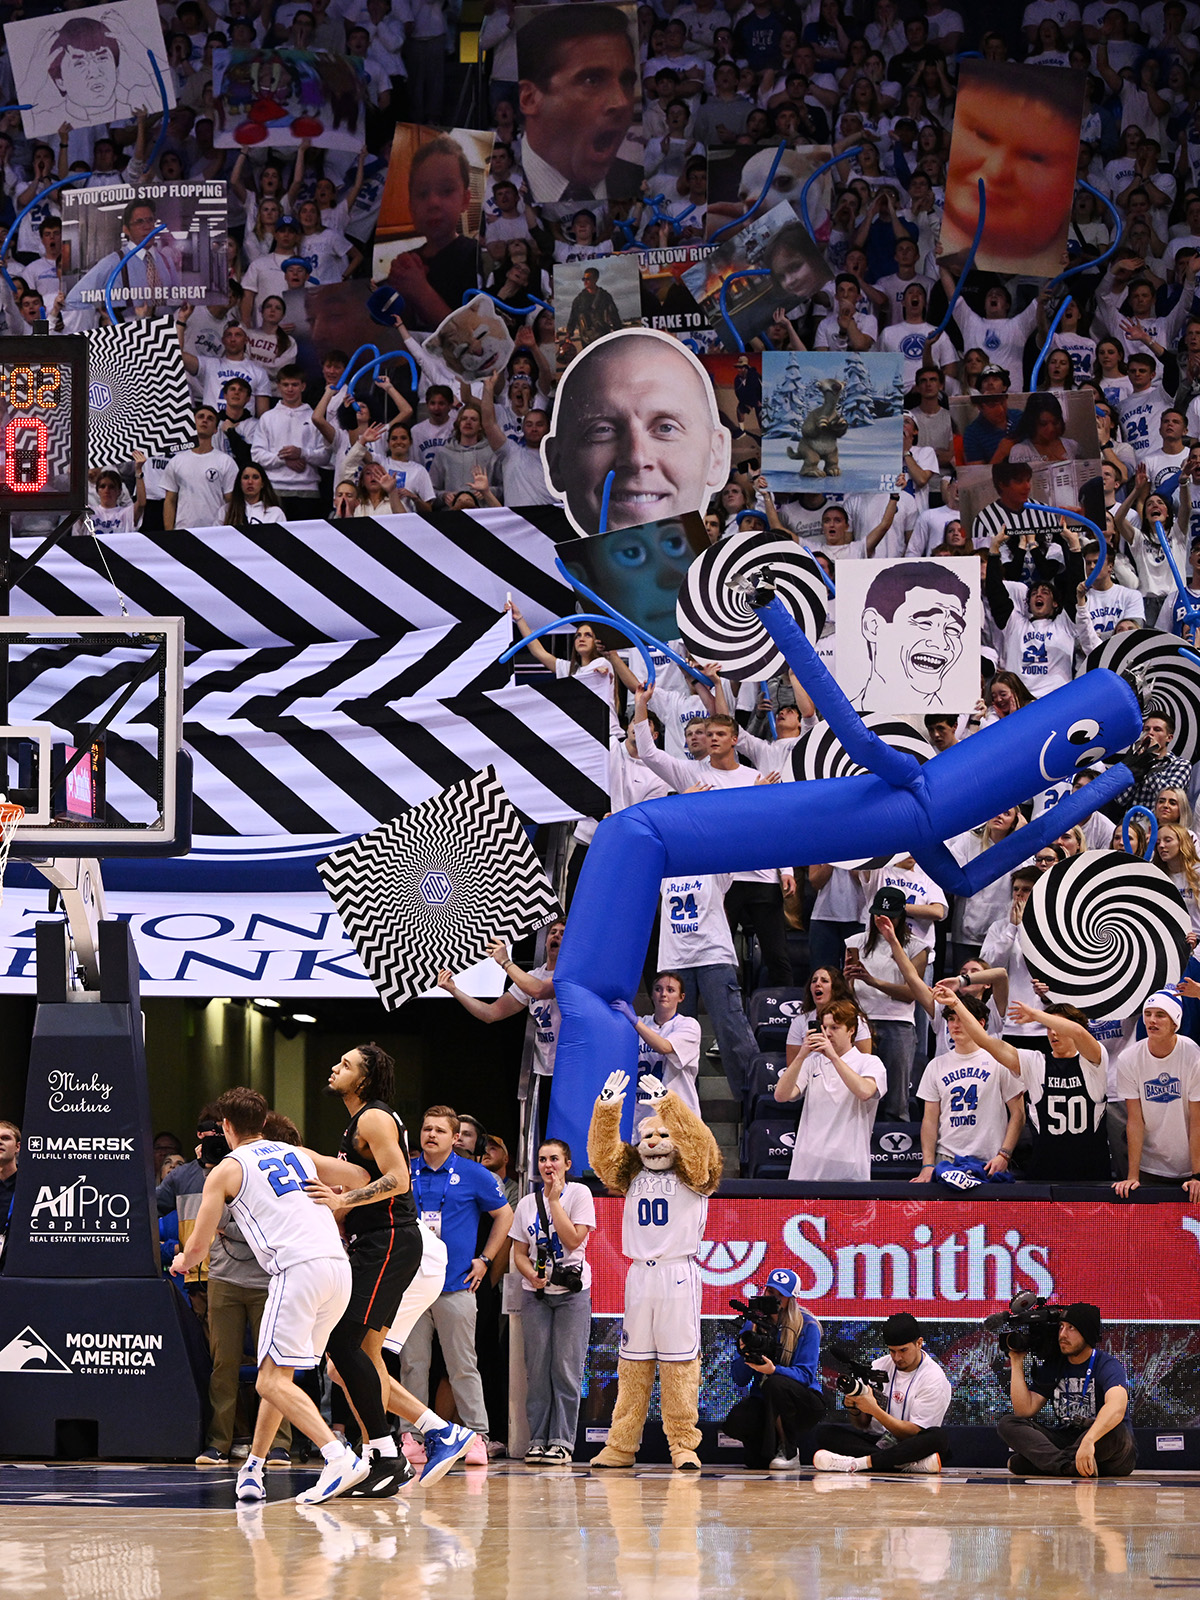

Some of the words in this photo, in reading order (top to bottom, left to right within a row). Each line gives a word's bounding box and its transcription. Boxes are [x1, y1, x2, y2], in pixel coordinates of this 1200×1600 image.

[65, 192, 76, 208] IF
[77, 191, 100, 206] YOU
[100, 187, 135, 204] COULD
[138, 186, 168, 200] STOP
[169, 184, 223, 199] FLOPPING
[648, 248, 686, 266] KNOW
[80, 288, 107, 303] THAT
[109, 286, 152, 300] WOULD
[154, 286, 169, 299] BE
[171, 285, 208, 299] GREAT
[651, 314, 683, 329] FAKE
[684, 312, 701, 327] TO
[194, 334, 224, 355] Loyal
[1126, 416, 1149, 442] 24
[169, 445, 184, 454] GET
[183, 442, 196, 452] LOUD
[1022, 631, 1053, 645] BRIGHAM
[1022, 643, 1048, 663] 24
[1021, 665, 1049, 675] YOUNG
[423, 875, 450, 901] ROC
[669, 893, 698, 920] 24
[531, 920, 543, 932] GET
[541, 911, 559, 927] LOUD
[670, 922, 699, 934] YOUNG
[766, 997, 777, 1005] 20
[769, 1016, 787, 1025] ROC
[765, 1062, 774, 1071] 12
[48, 1069, 113, 1099] Minky
[941, 1067, 991, 1087] BRIGHAM
[1047, 1075, 1082, 1089] KHALIFA
[48, 1091, 111, 1113] Couture
[949, 1083, 979, 1113] 24
[949, 1115, 977, 1128] YOUNG
[1047, 1095, 1088, 1135] 50
[46, 1137, 135, 1151] MAERSK
[251, 1144, 284, 1158] KNELL
[769, 1147, 788, 1156] ROC
[32, 1152, 64, 1160] FULFILL
[98, 1153, 131, 1161] DELIVER
[870, 1154, 889, 1162] ROC
[892, 1152, 923, 1162] BOARD
[257, 1152, 309, 1197] 21
[631, 1176, 678, 1197] BYU
[638, 1198, 669, 1227] 00
[29, 1218, 130, 1232] Capital
[782, 1212, 1055, 1301] Smith's
[65, 1333, 163, 1350] MOUNTAIN
[70, 1350, 156, 1367] AMERICA
[80, 1367, 114, 1375] CREDIT
